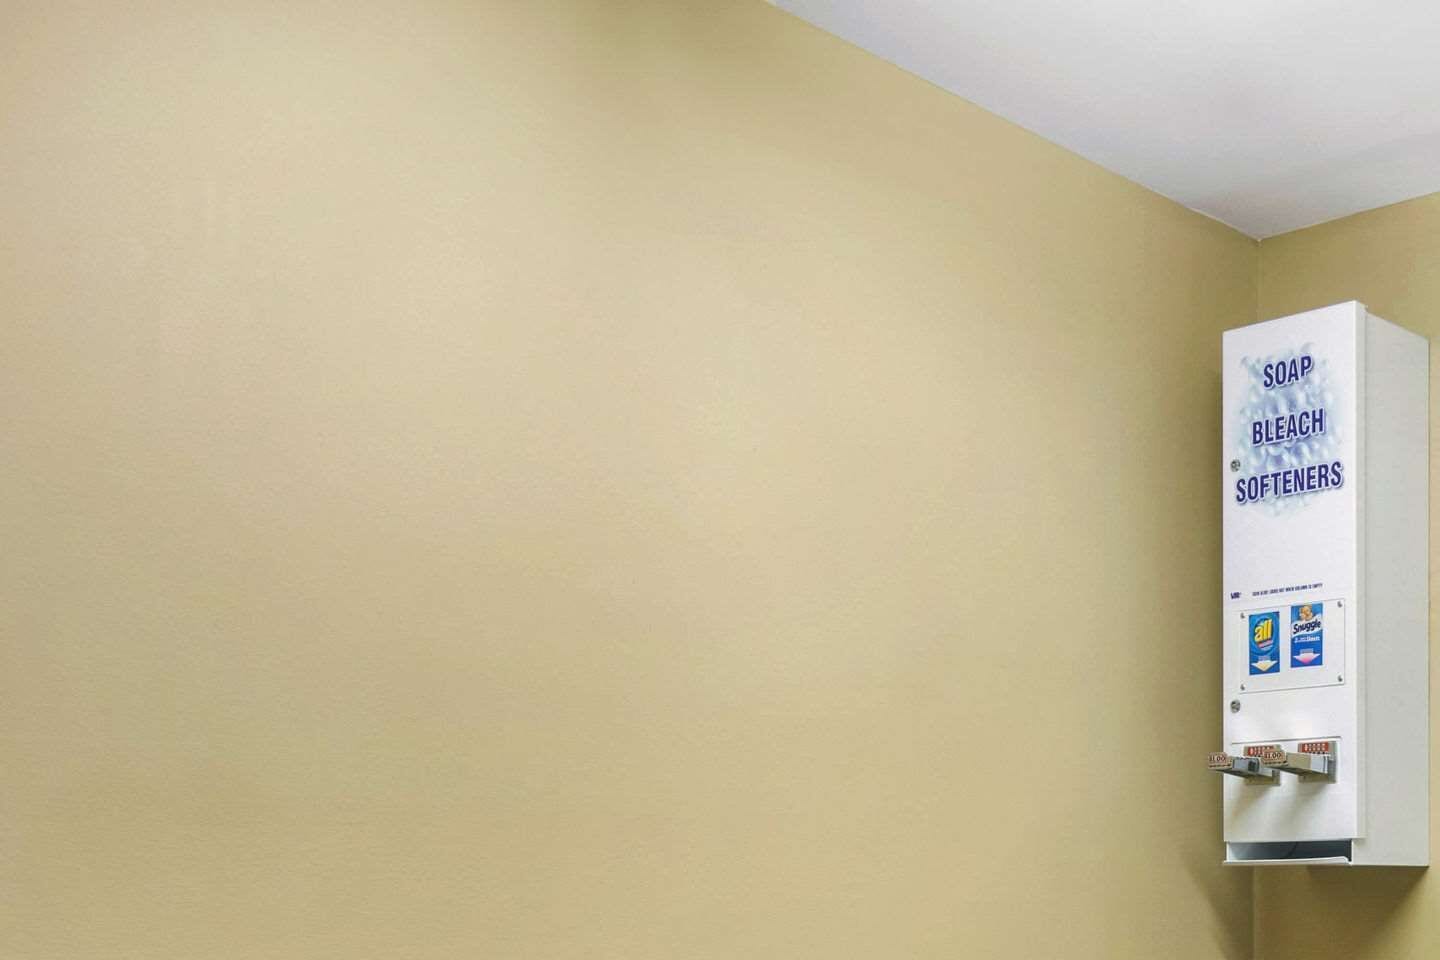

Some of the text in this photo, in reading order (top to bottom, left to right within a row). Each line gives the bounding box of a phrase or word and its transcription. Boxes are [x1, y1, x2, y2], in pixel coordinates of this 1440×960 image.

[1263, 355, 1312, 388] SOAP
[1252, 408, 1324, 445] BLEACH
[1236, 461, 1342, 502] SOFTENERS
[1254, 619, 1272, 642] all
[1293, 619, 1321, 635] Snuggle
